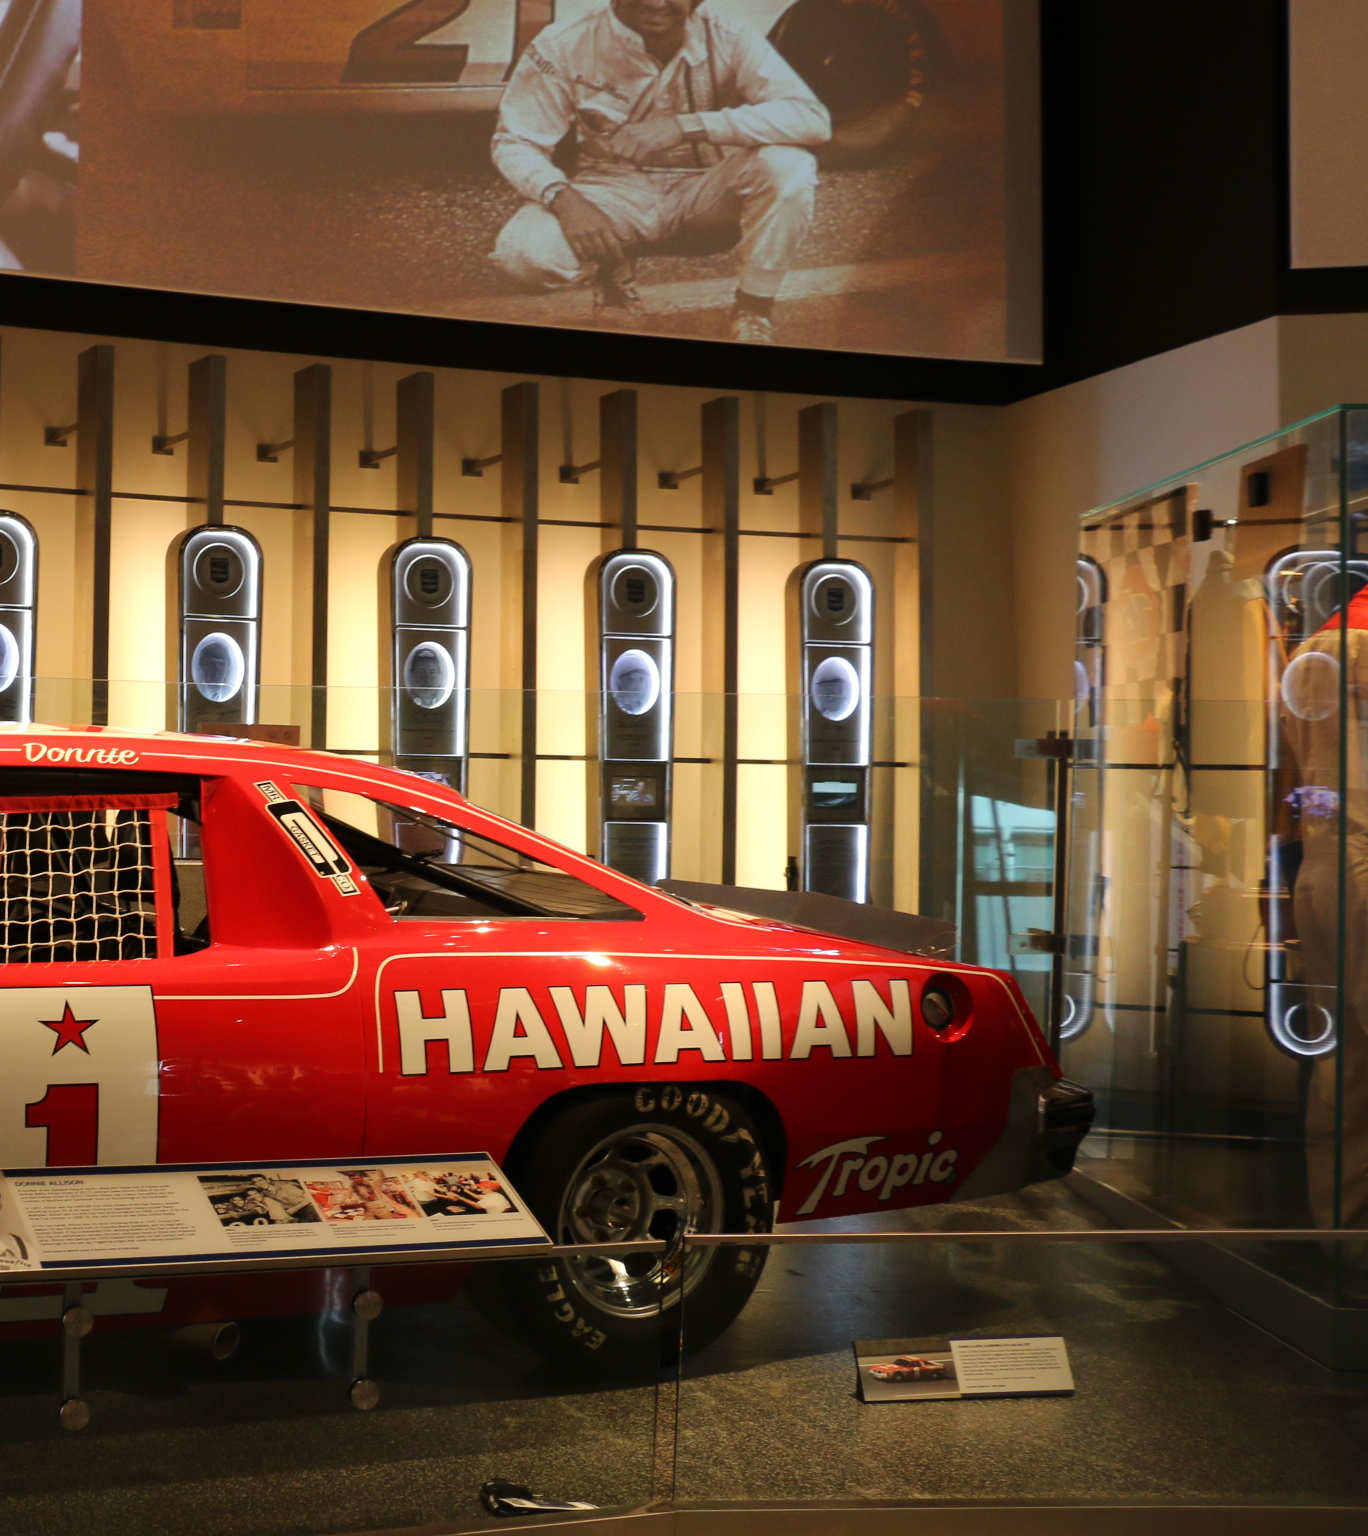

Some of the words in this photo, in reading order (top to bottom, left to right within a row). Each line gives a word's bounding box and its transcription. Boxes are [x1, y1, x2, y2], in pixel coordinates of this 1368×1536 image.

[23, 742, 139, 765] Donnie
[290, 825, 321, 857] GASKET
[394, 979, 914, 1076] HAWAIIAN
[794, 1130, 958, 1216] Tropic
[538, 1264, 608, 1350] EAGLE
